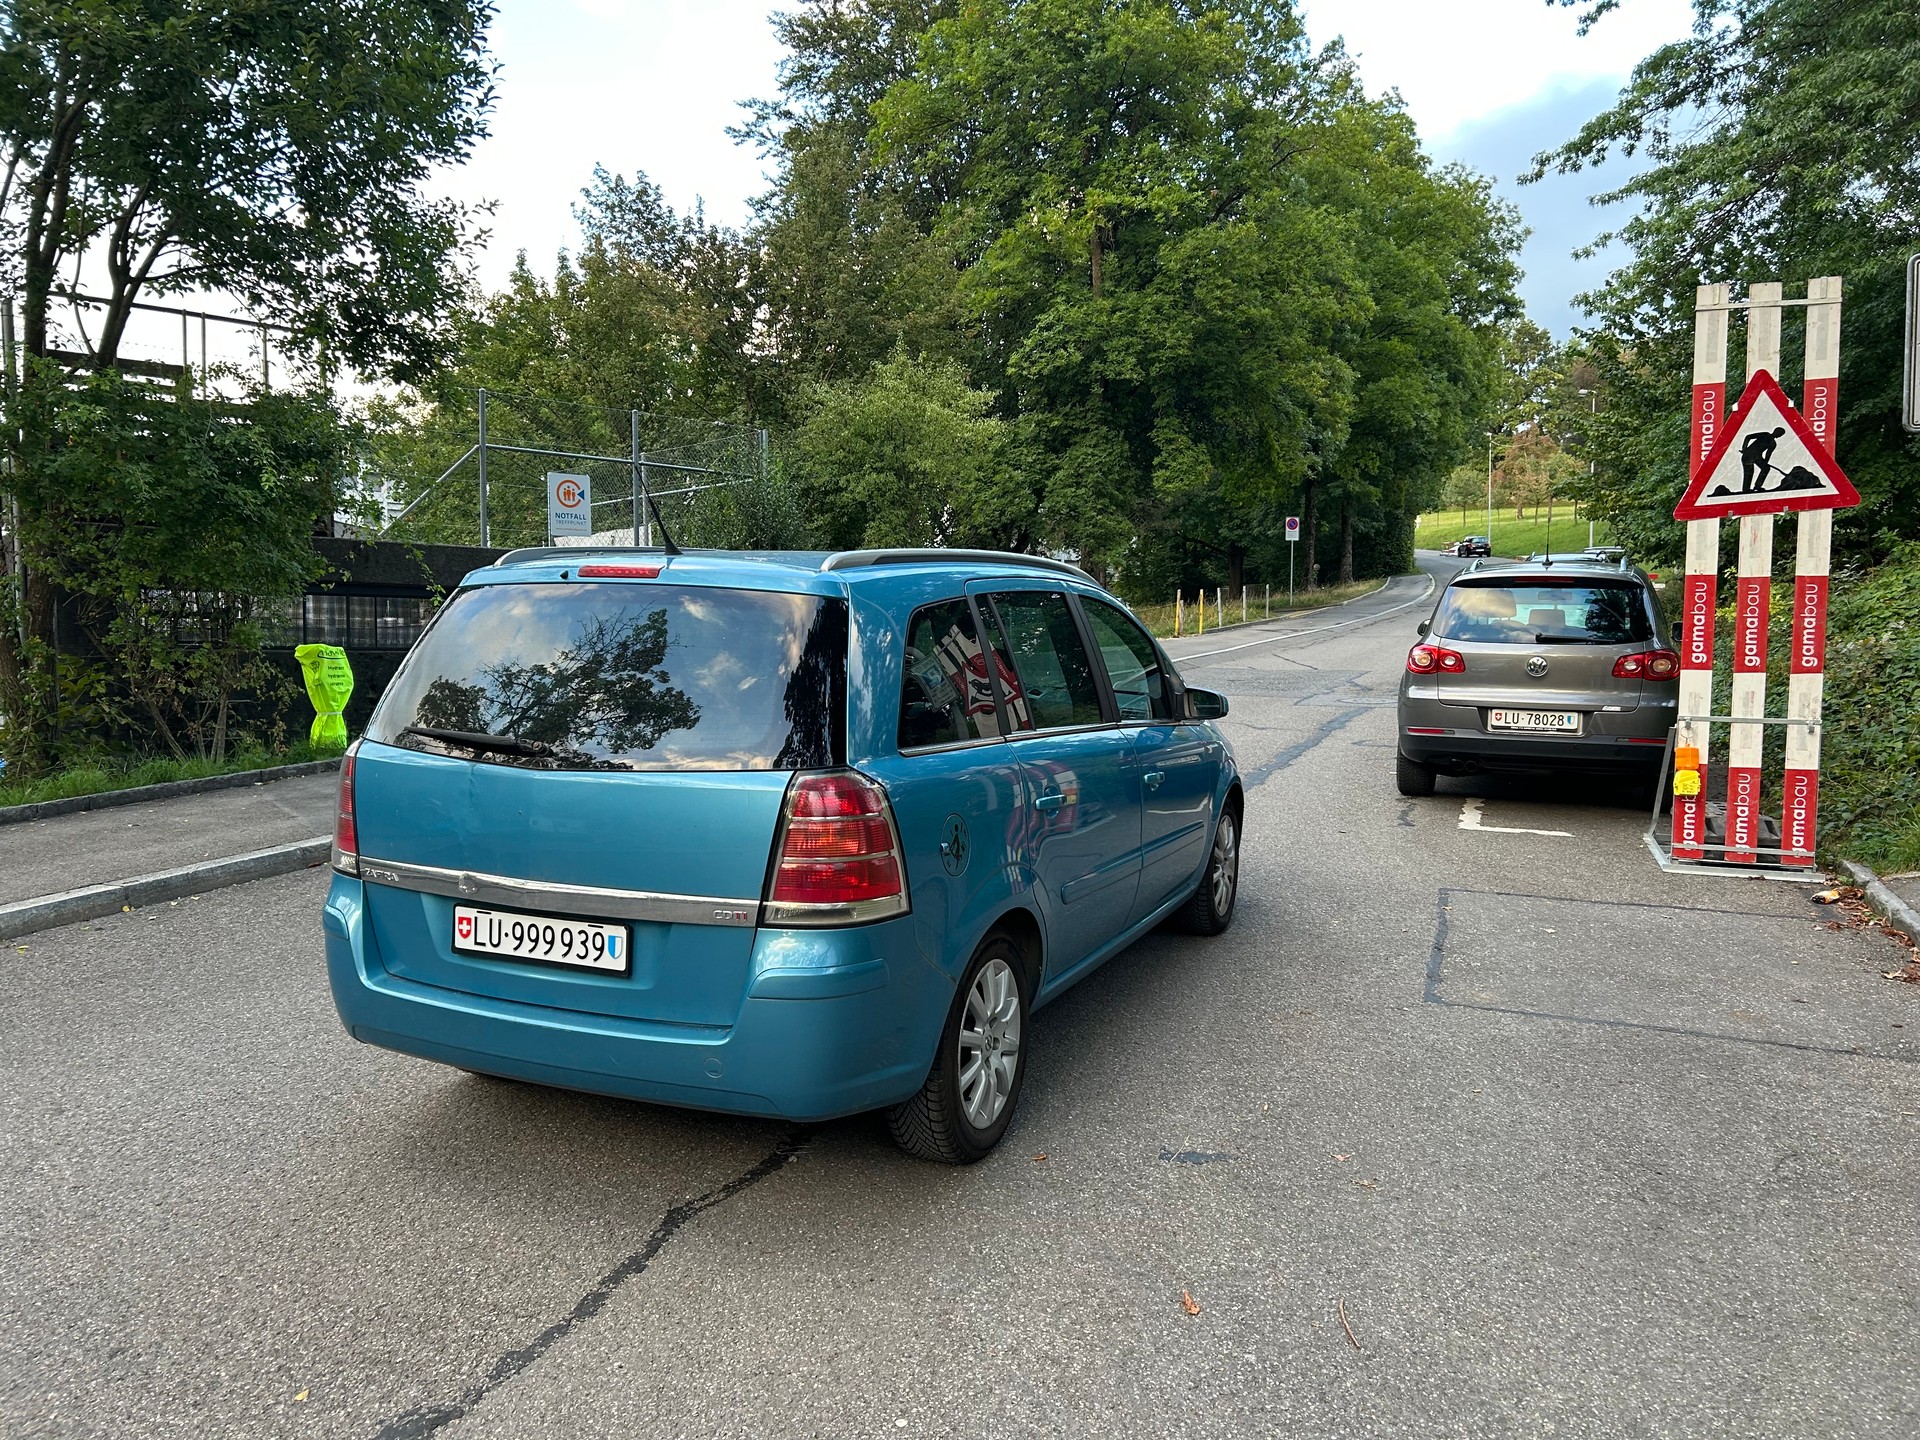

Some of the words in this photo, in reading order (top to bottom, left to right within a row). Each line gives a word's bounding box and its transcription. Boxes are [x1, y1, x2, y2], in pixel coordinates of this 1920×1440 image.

[1698, 390, 1716, 462] amabau
[555, 512, 587, 521] NOTFALL
[1690, 582, 1707, 664] gamabau
[1743, 584, 1760, 667] gamabau
[1800, 583, 1818, 667] gamabau
[1682, 795, 1697, 851] gamab
